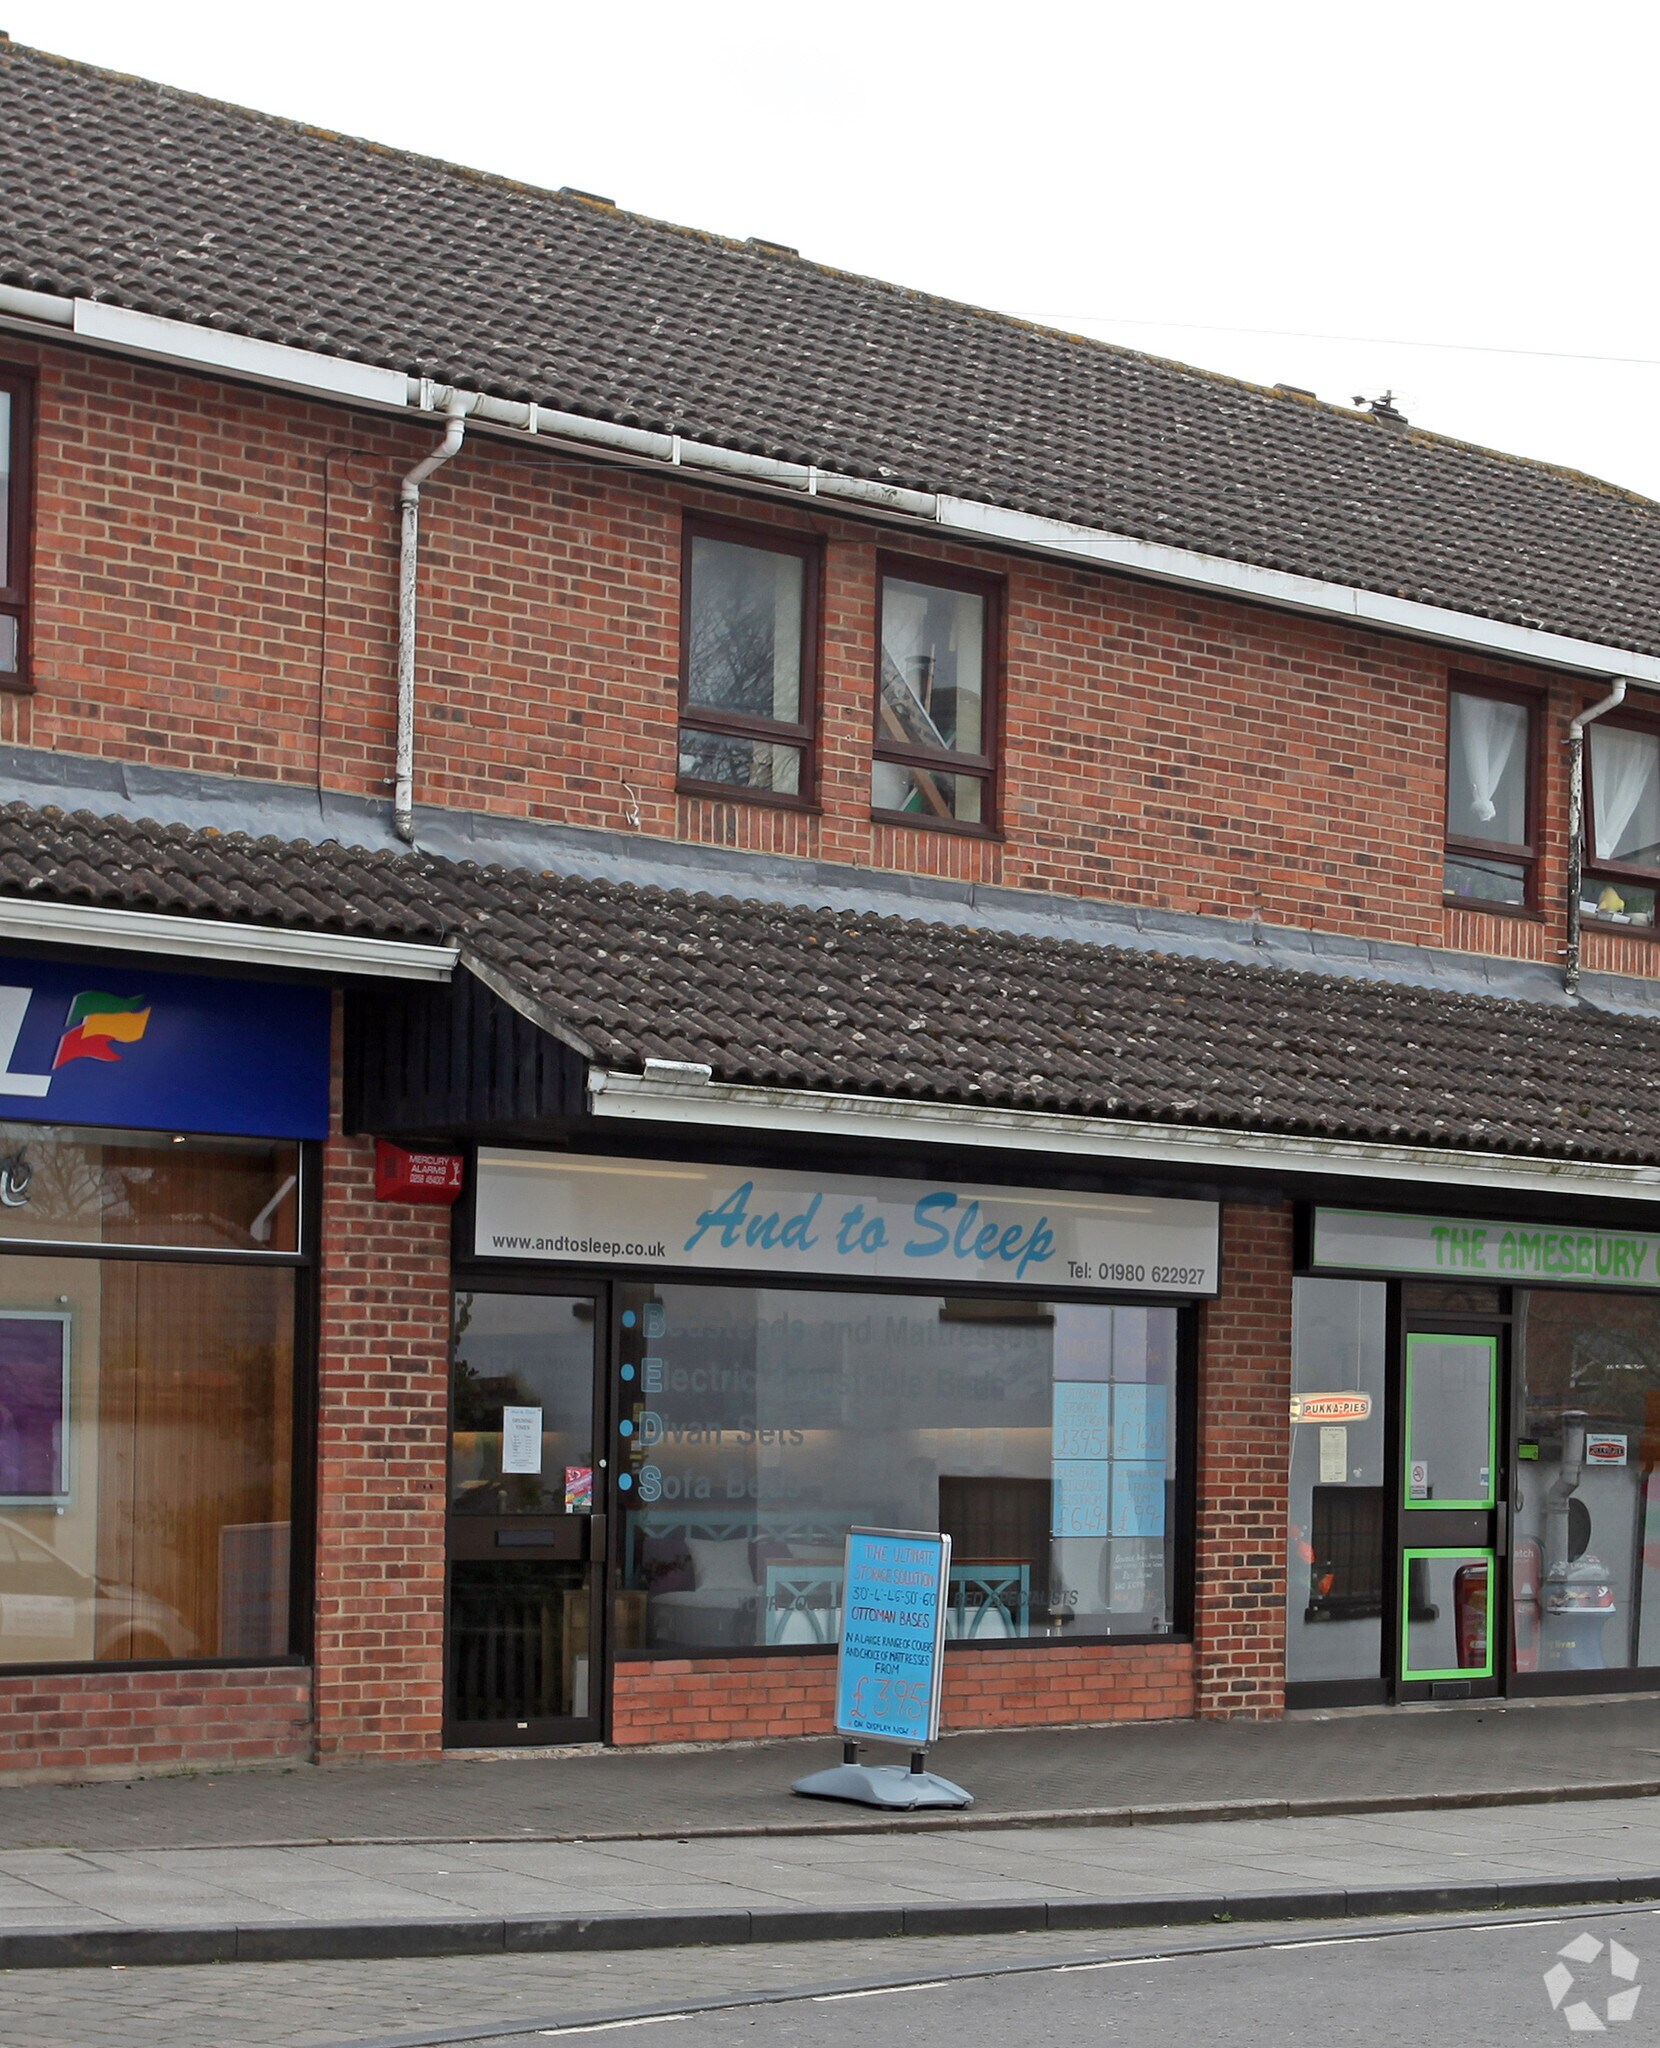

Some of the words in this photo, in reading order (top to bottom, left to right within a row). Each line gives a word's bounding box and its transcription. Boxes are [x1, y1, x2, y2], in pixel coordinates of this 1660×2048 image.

[409, 1154, 449, 1166] MERCURY
[411, 1164, 447, 1175] ALARMS
[684, 1180, 823, 1252] And
[836, 1203, 890, 1254] to
[903, 1191, 1057, 1280] Sleep
[492, 1234, 666, 1258] www.andtosleep.co.uk
[1430, 1226, 1488, 1268] THE
[1497, 1230, 1648, 1278] AMESBURY
[1067, 1261, 1092, 1279] Tel:
[1098, 1263, 1146, 1283] 01980
[1151, 1265, 1206, 1286] 622927
[1305, 1403, 1366, 1414] PUKKA-PIES
[639, 1411, 722, 1446] Divan
[638, 1465, 711, 1502] Sofa
[864, 1543, 888, 1562] THE
[851, 1606, 896, 1624] OTTOMAN
[899, 1610, 930, 1629] BASES
[874, 1662, 900, 1675] FROM
